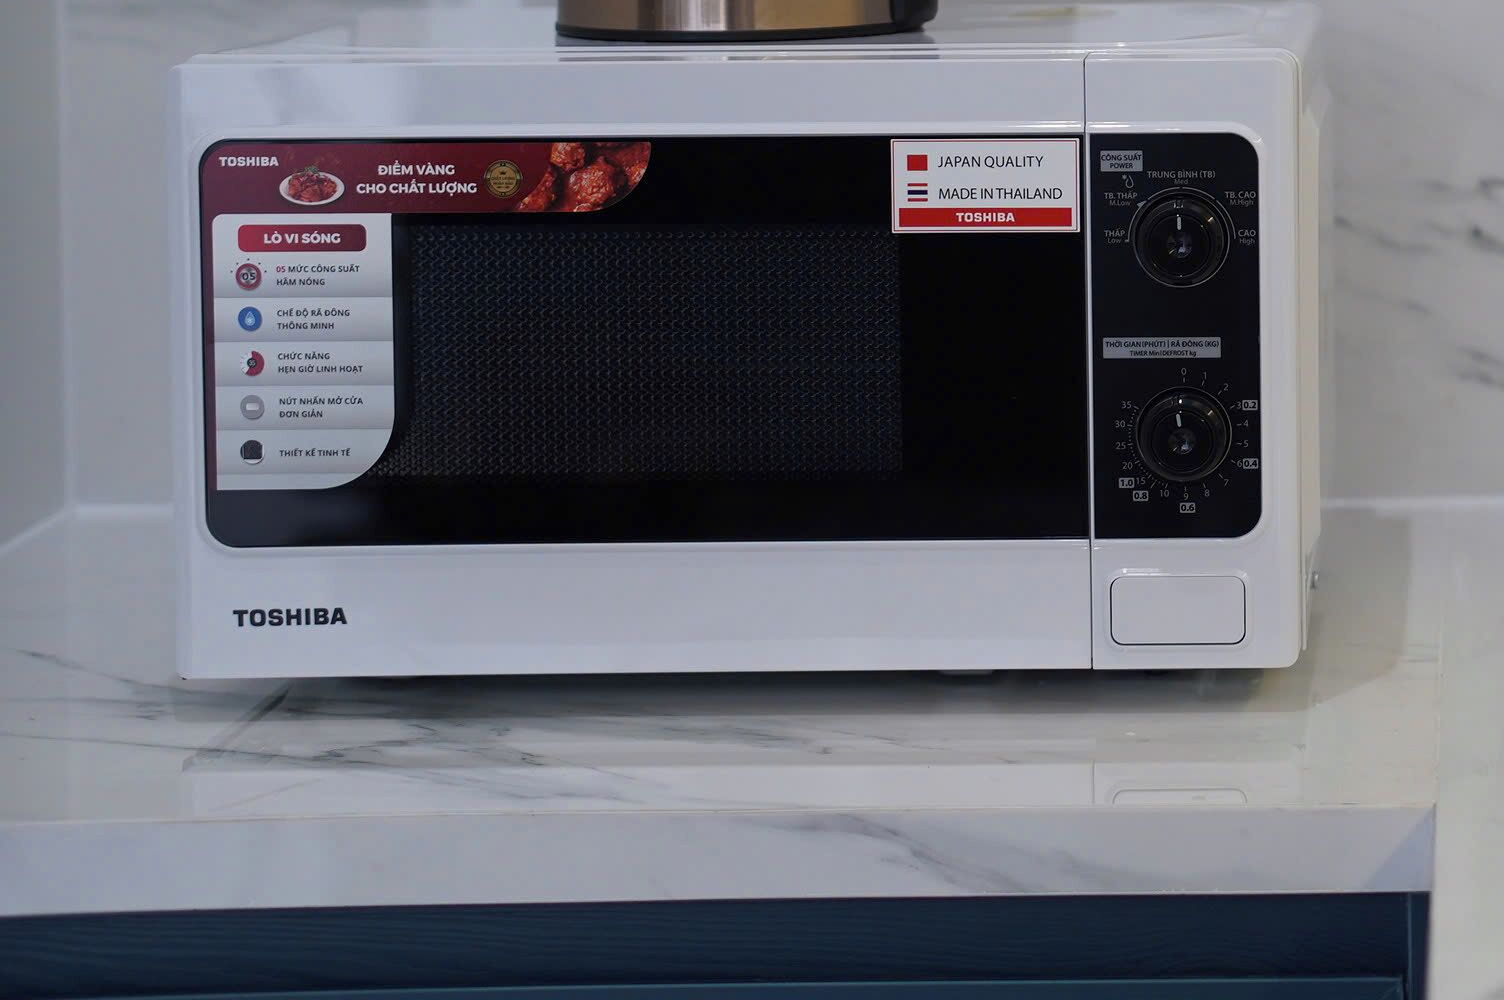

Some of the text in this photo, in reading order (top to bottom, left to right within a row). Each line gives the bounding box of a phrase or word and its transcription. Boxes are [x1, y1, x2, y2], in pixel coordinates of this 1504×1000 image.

[1101, 152, 1142, 161] CÔNG SUẤT
[219, 156, 279, 167] TOSHIBA
[938, 156, 1044, 169] JAPAN QUALITY
[378, 160, 455, 175] ĐIỂM VÀNG
[1178, 168, 1198, 178] BÌNH
[356, 179, 477, 196] CHO CHẤT LƯỢNG
[938, 188, 1063, 199] MADE IN THAILAND
[1117, 191, 1138, 199] THẤP
[956, 212, 1015, 222] TOSHIBA
[263, 231, 341, 243] LÒ VI SÓNG
[1104, 229, 1125, 237] THẤP
[311, 264, 336, 272] CÔNG
[338, 264, 360, 272] SUẤT
[299, 277, 326, 286] NÓNG
[277, 308, 350, 318] CHẾ ĐỘ RÃ ĐÔNG
[1205, 340, 1219, 348] (KG)
[278, 352, 330, 360] CHỨC NĂNG
[278, 366, 296, 374] HẸN
[298, 365, 315, 373] GIỜ
[339, 366, 363, 374] HOẠT
[300, 397, 325, 405] NHẤN
[328, 397, 343, 405] MỞ
[1122, 401, 1132, 409] 35
[1243, 401, 1257, 409] 0.2
[301, 410, 323, 418] GIẢN
[1115, 420, 1126, 428] 30
[1116, 442, 1126, 450] 25
[1243, 440, 1249, 448] 5
[279, 448, 303, 457] THIẾT
[305, 448, 316, 457] KẾ
[1122, 462, 1132, 470] 20
[1243, 460, 1258, 468] 0.4
[1120, 479, 1133, 487] 1.0
[1136, 477, 1146, 485] 15
[1224, 479, 1229, 487] 7
[1134, 492, 1147, 500] 0.8
[1160, 489, 1169, 497] 10
[1205, 489, 1210, 497] 8
[233, 607, 348, 627] TOSHIBA
